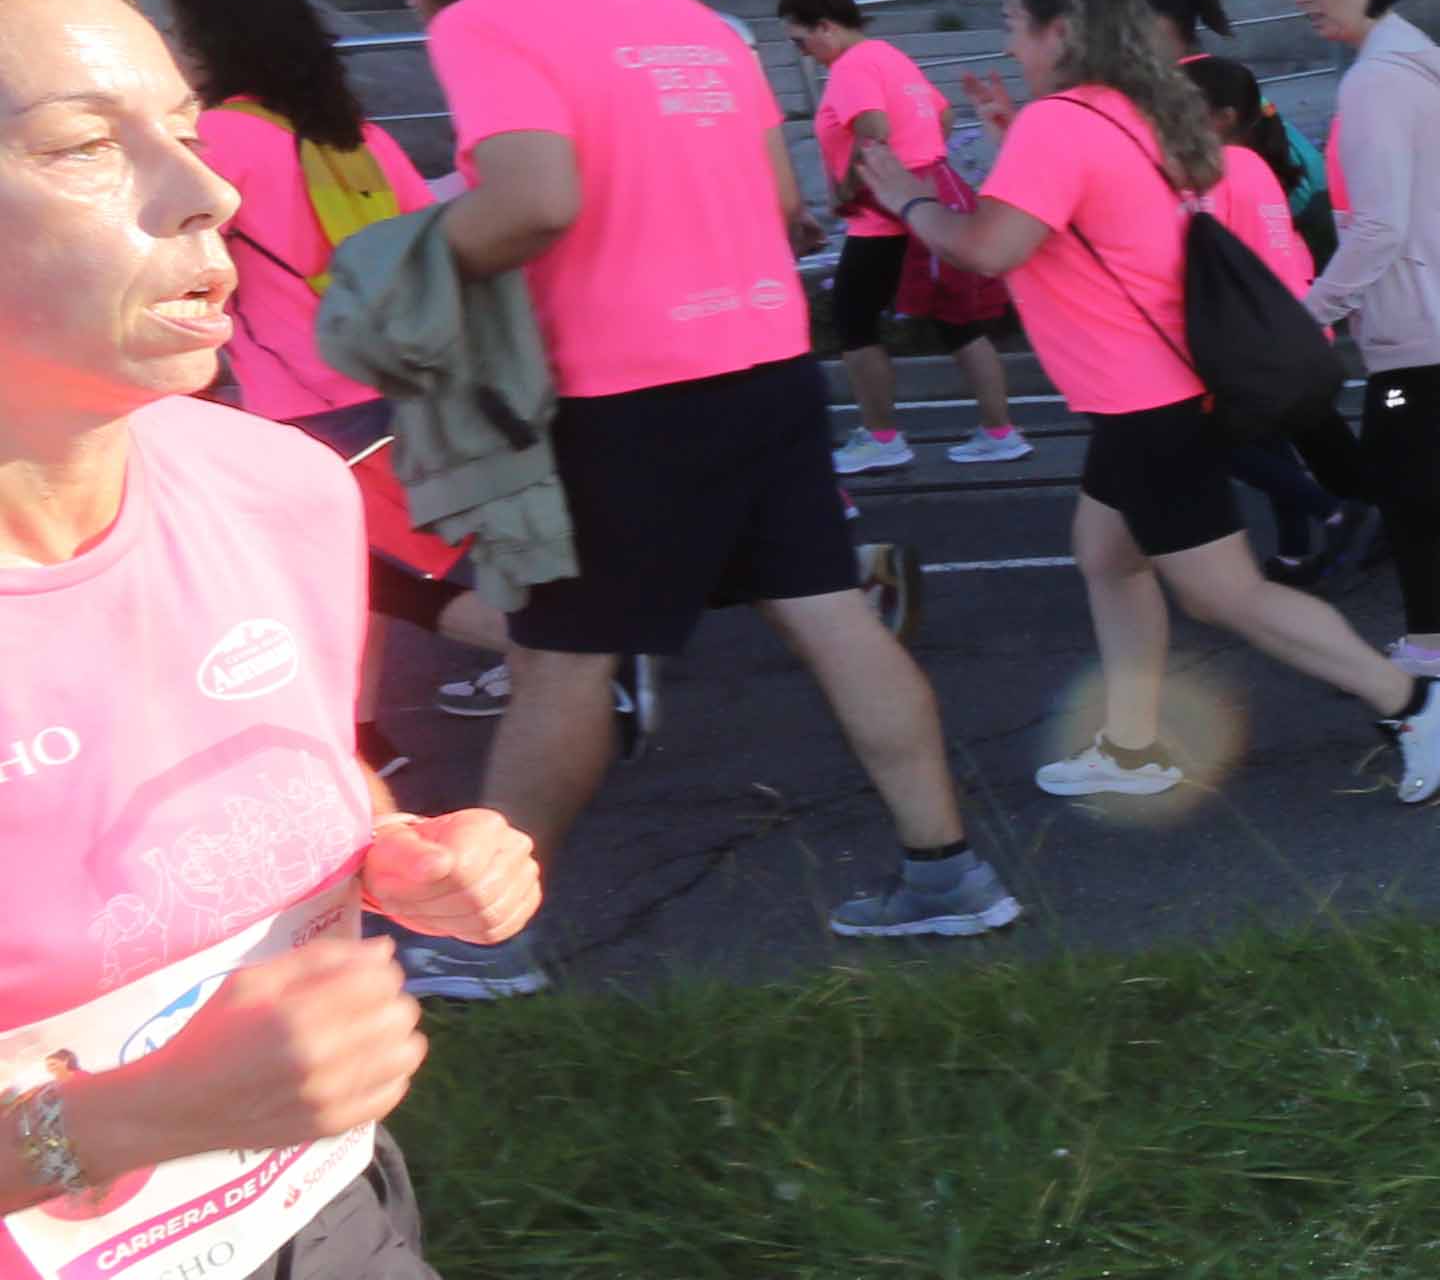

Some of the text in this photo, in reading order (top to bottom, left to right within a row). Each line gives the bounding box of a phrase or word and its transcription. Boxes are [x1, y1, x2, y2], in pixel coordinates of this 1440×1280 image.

[97, 1200, 219, 1271] CARRERA
[223, 1176, 258, 1209] DE
[258, 1160, 280, 1187] LA
